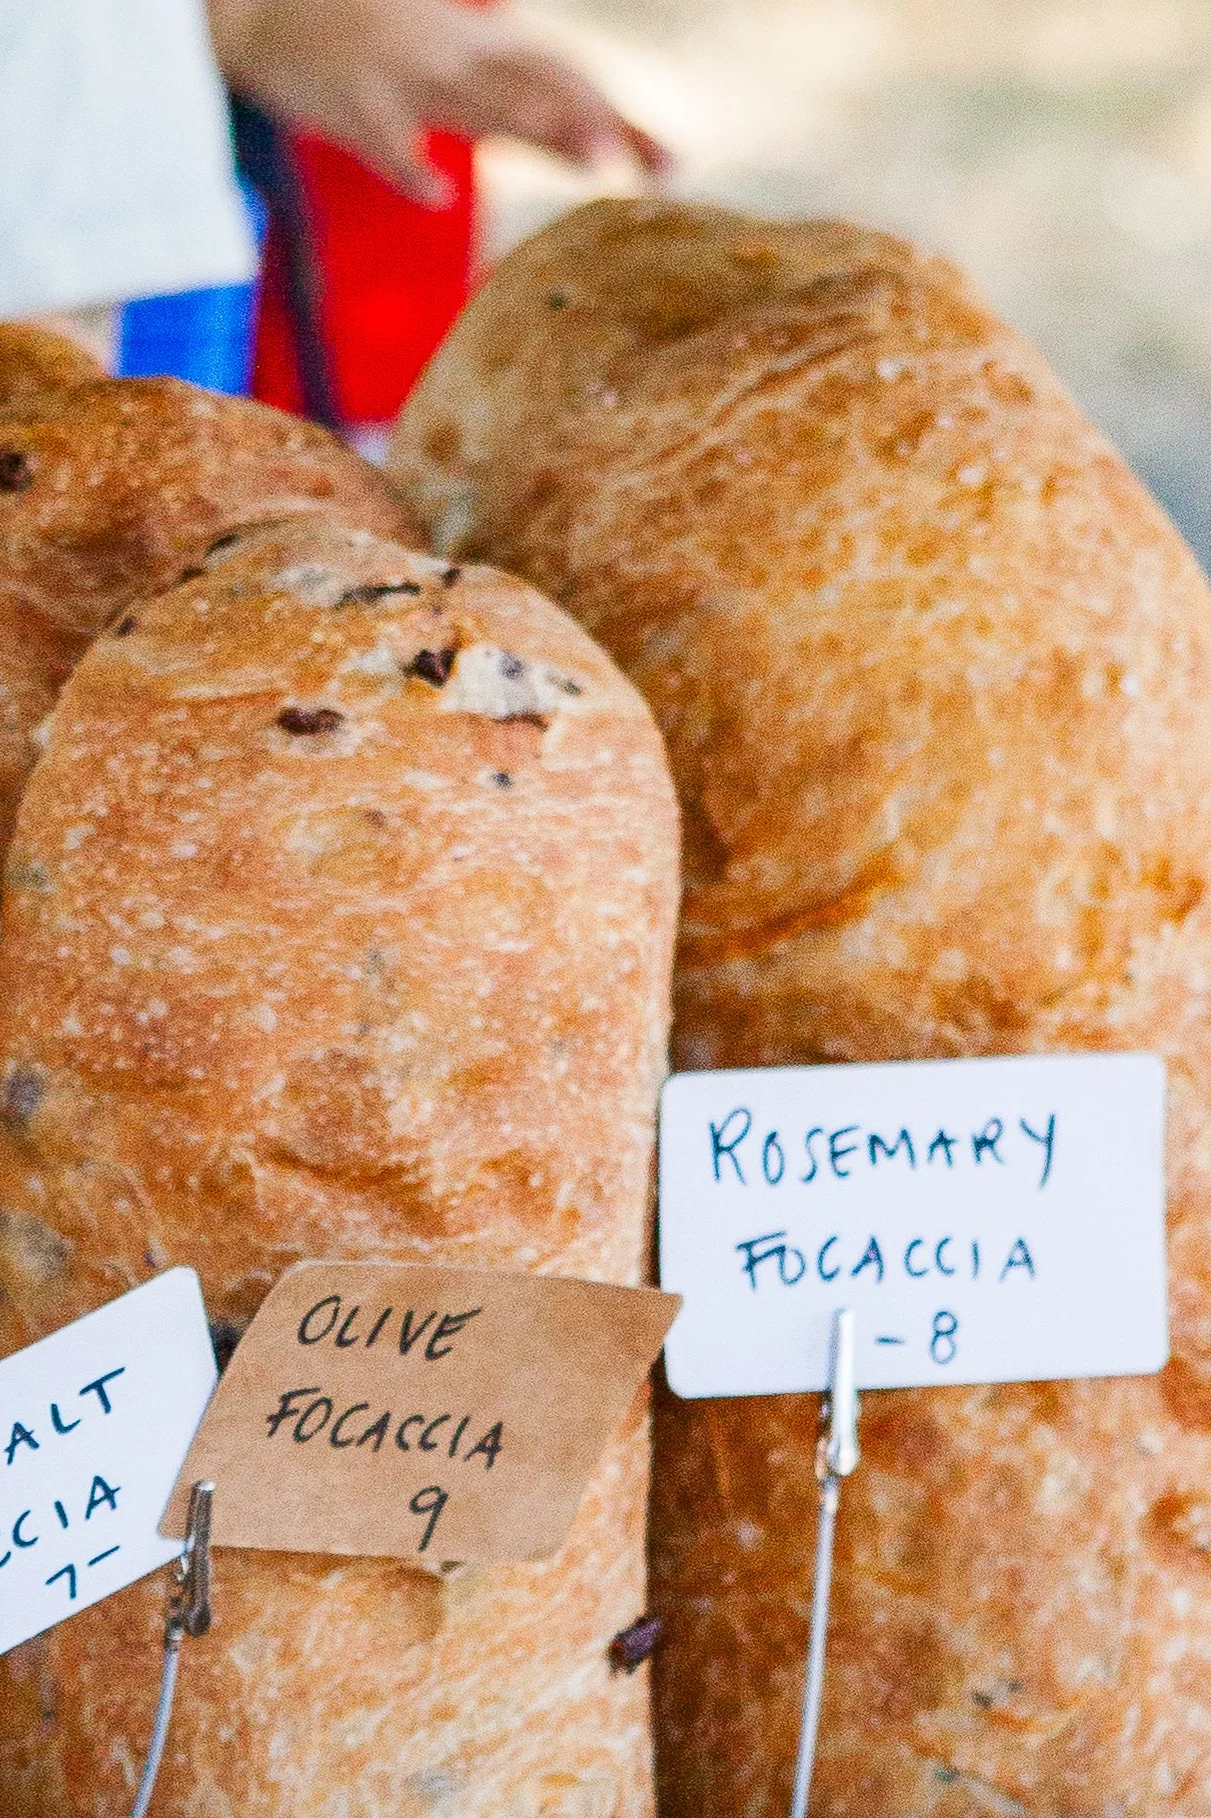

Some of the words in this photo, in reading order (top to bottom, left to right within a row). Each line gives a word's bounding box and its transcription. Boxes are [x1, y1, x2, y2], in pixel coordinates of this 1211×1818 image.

[708, 1105, 1058, 1191] ROSEMARY
[734, 1231, 1037, 1291] FOCACCIA
[297, 1294, 484, 1361] OLIVE
[266, 1386, 505, 1470] FOCACCIA
[408, 1484, 450, 1553] 9
